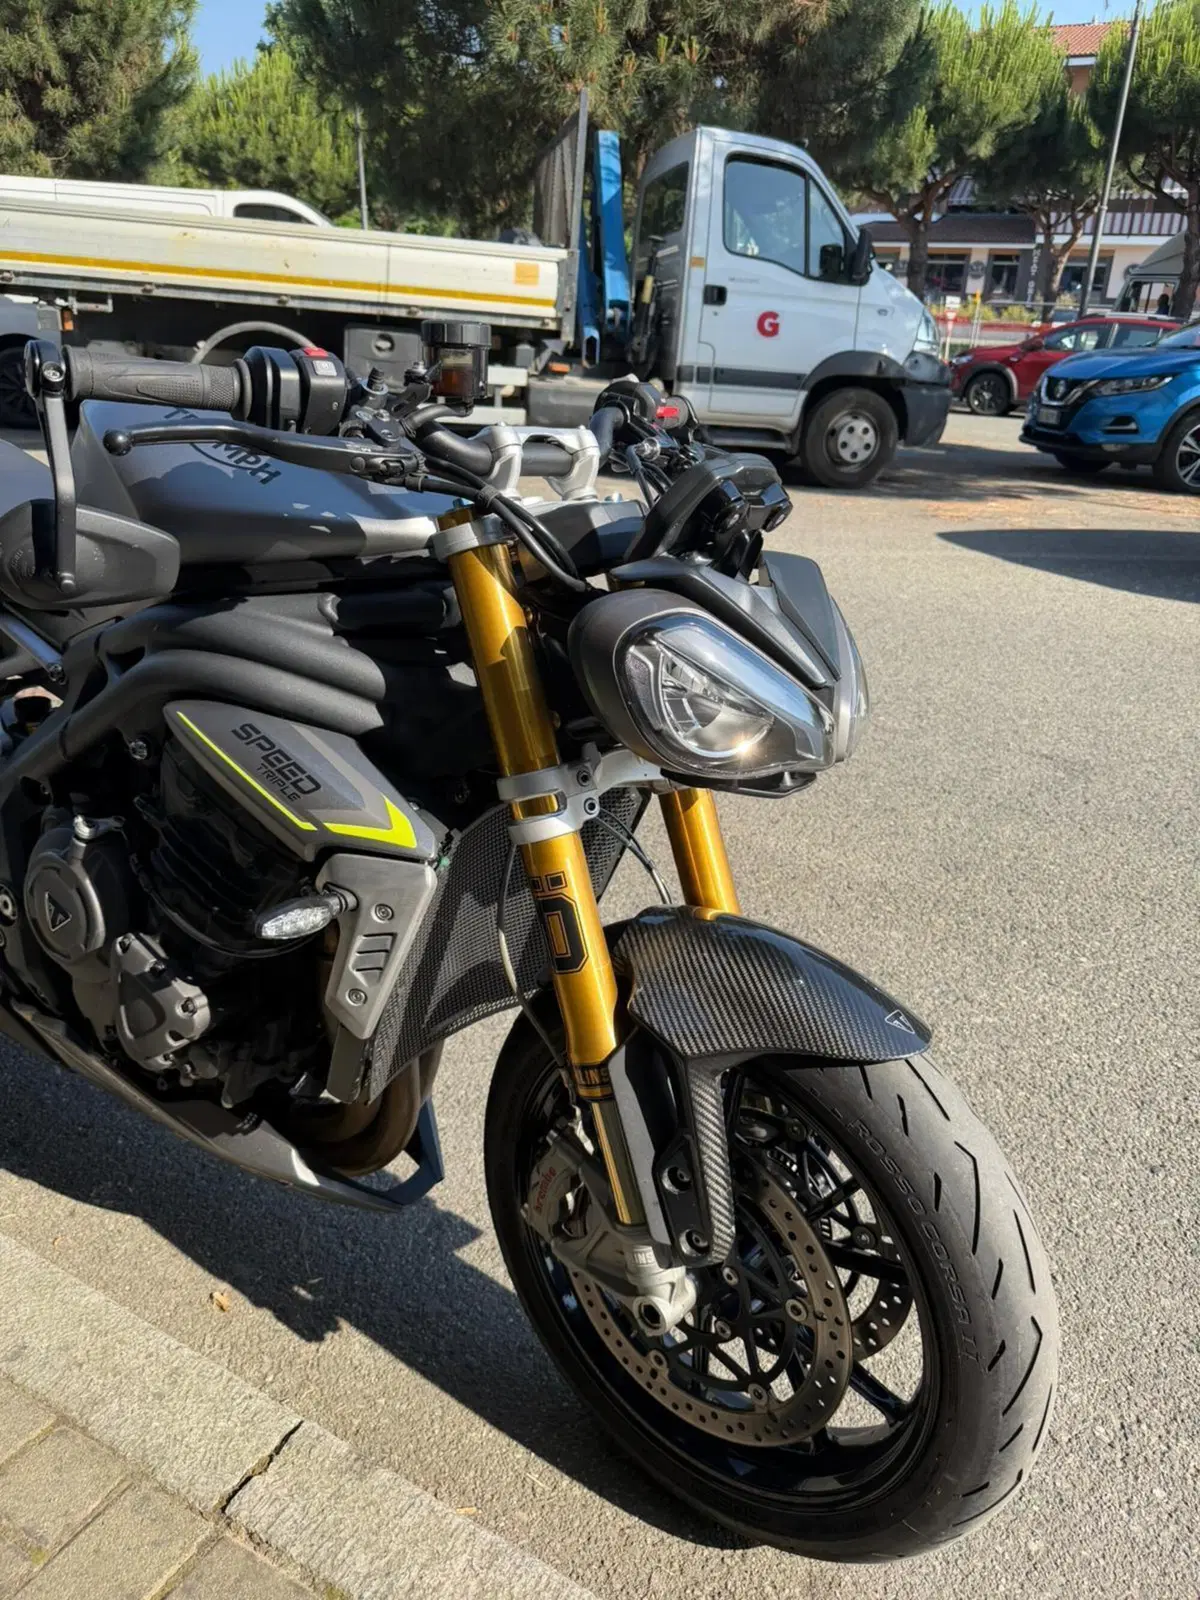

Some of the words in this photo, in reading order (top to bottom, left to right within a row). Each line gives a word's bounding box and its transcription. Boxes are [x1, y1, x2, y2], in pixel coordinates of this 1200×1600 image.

[757, 311, 780, 338] G
[164, 407, 281, 485] TMPH
[231, 723, 322, 795] SPEED
[257, 762, 302, 802] TRIPLE
[577, 1067, 609, 1086] LINS
[848, 1117, 927, 1216] ROSSO
[921, 1220, 971, 1325] CORSA
[633, 1251, 656, 1265] INS
